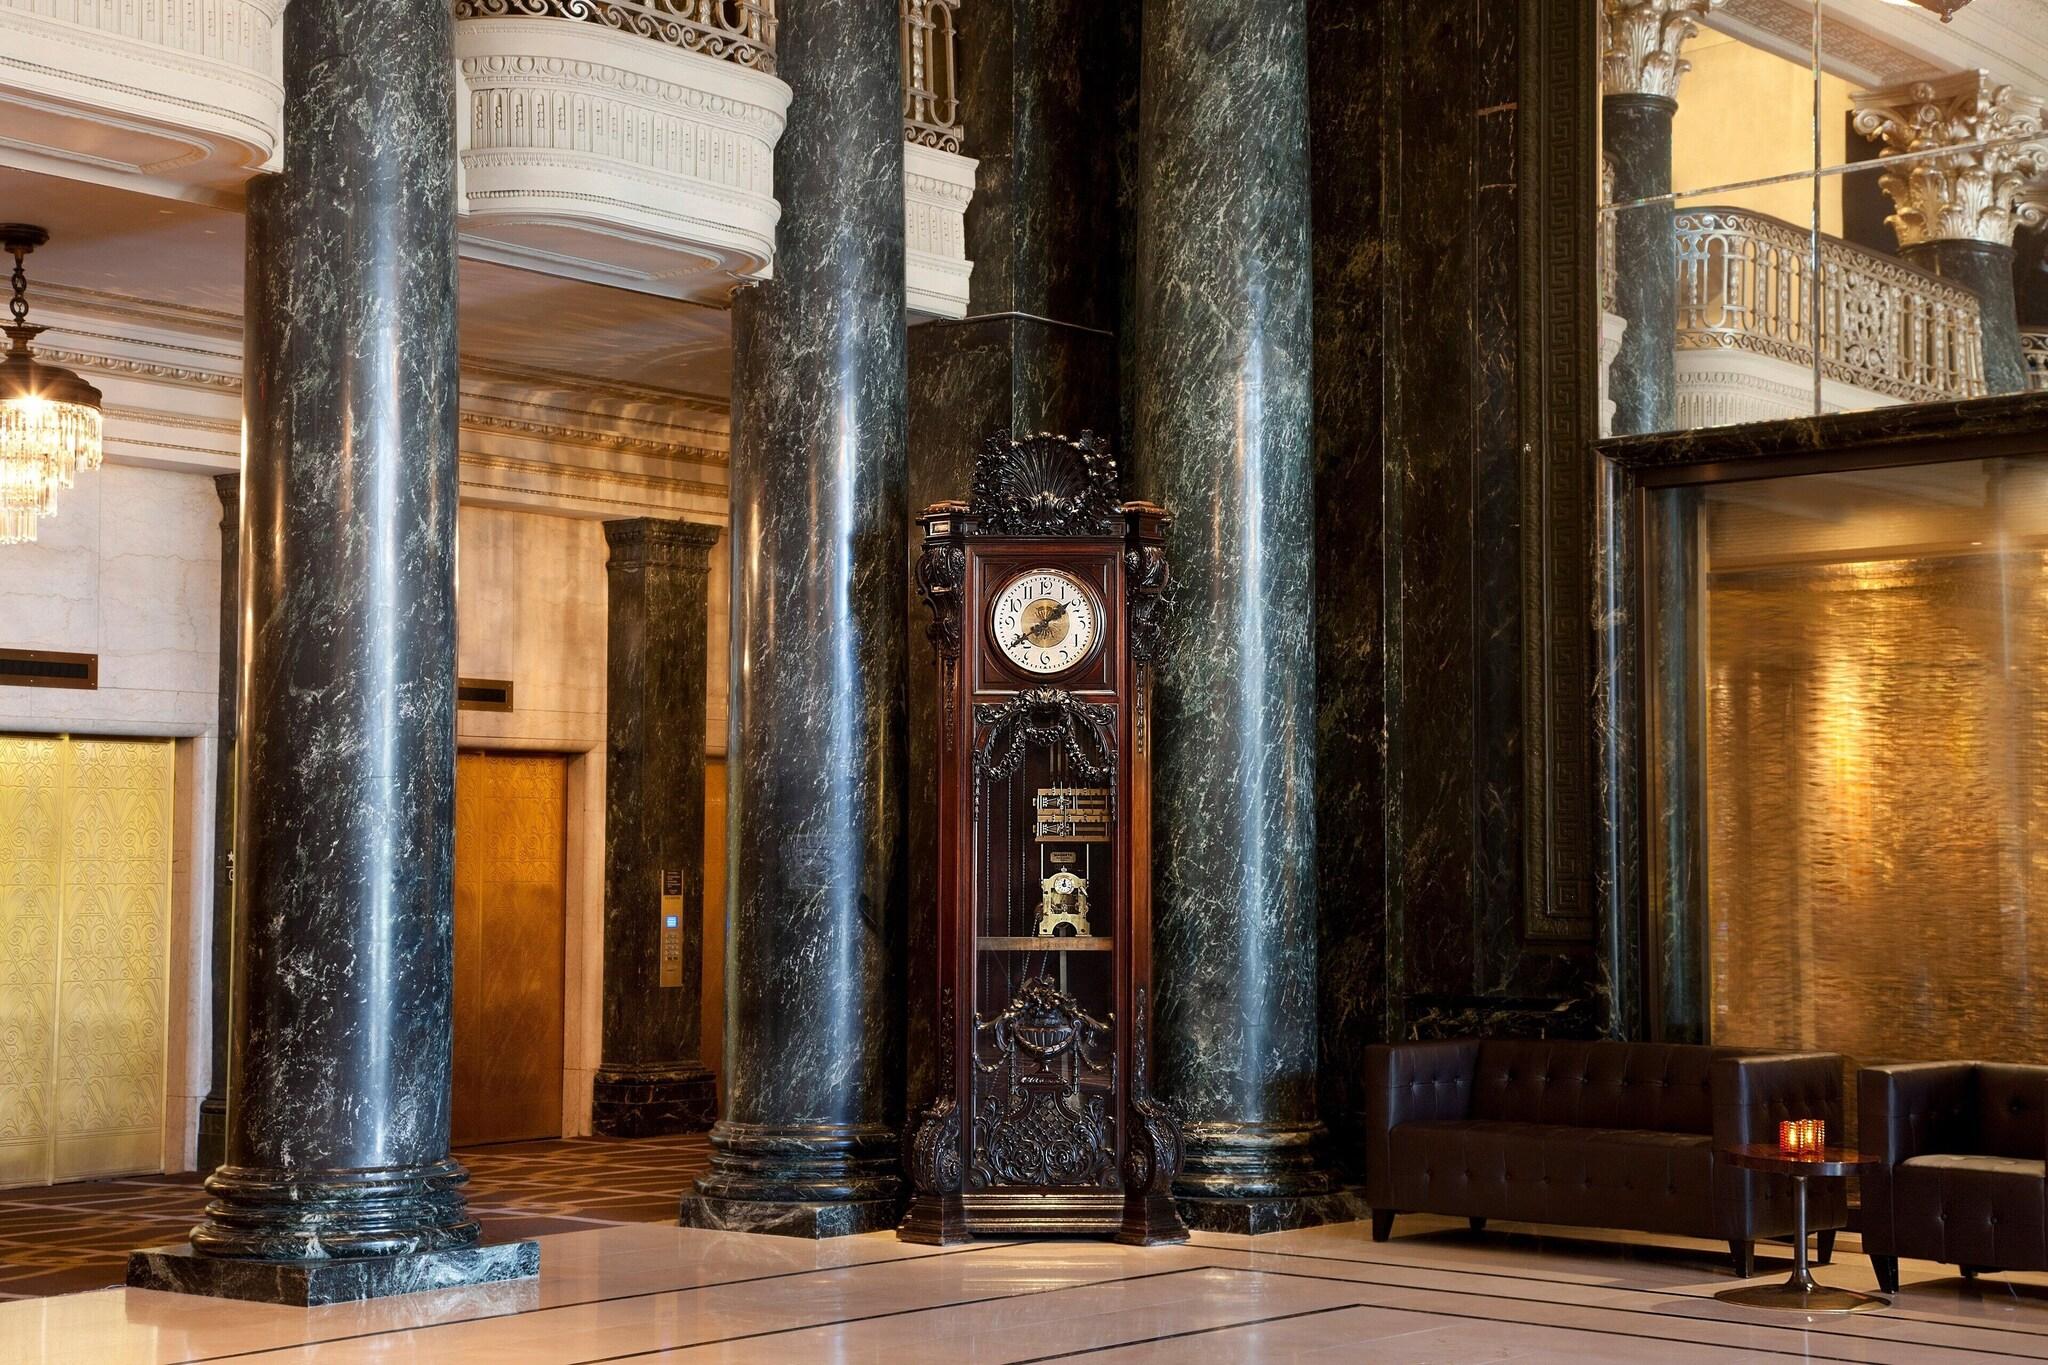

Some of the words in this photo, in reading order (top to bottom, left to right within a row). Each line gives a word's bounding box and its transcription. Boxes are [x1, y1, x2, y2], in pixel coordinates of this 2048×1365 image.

[1024, 586, 1033, 599] 11
[1040, 581, 1053, 595] 12
[1061, 586, 1065, 599] 1
[1010, 598, 1022, 612] 10
[1072, 599, 1081, 612] 2
[1005, 616, 1015, 630] 9
[1023, 646, 1031, 660] 7
[1040, 650, 1050, 665] 6
